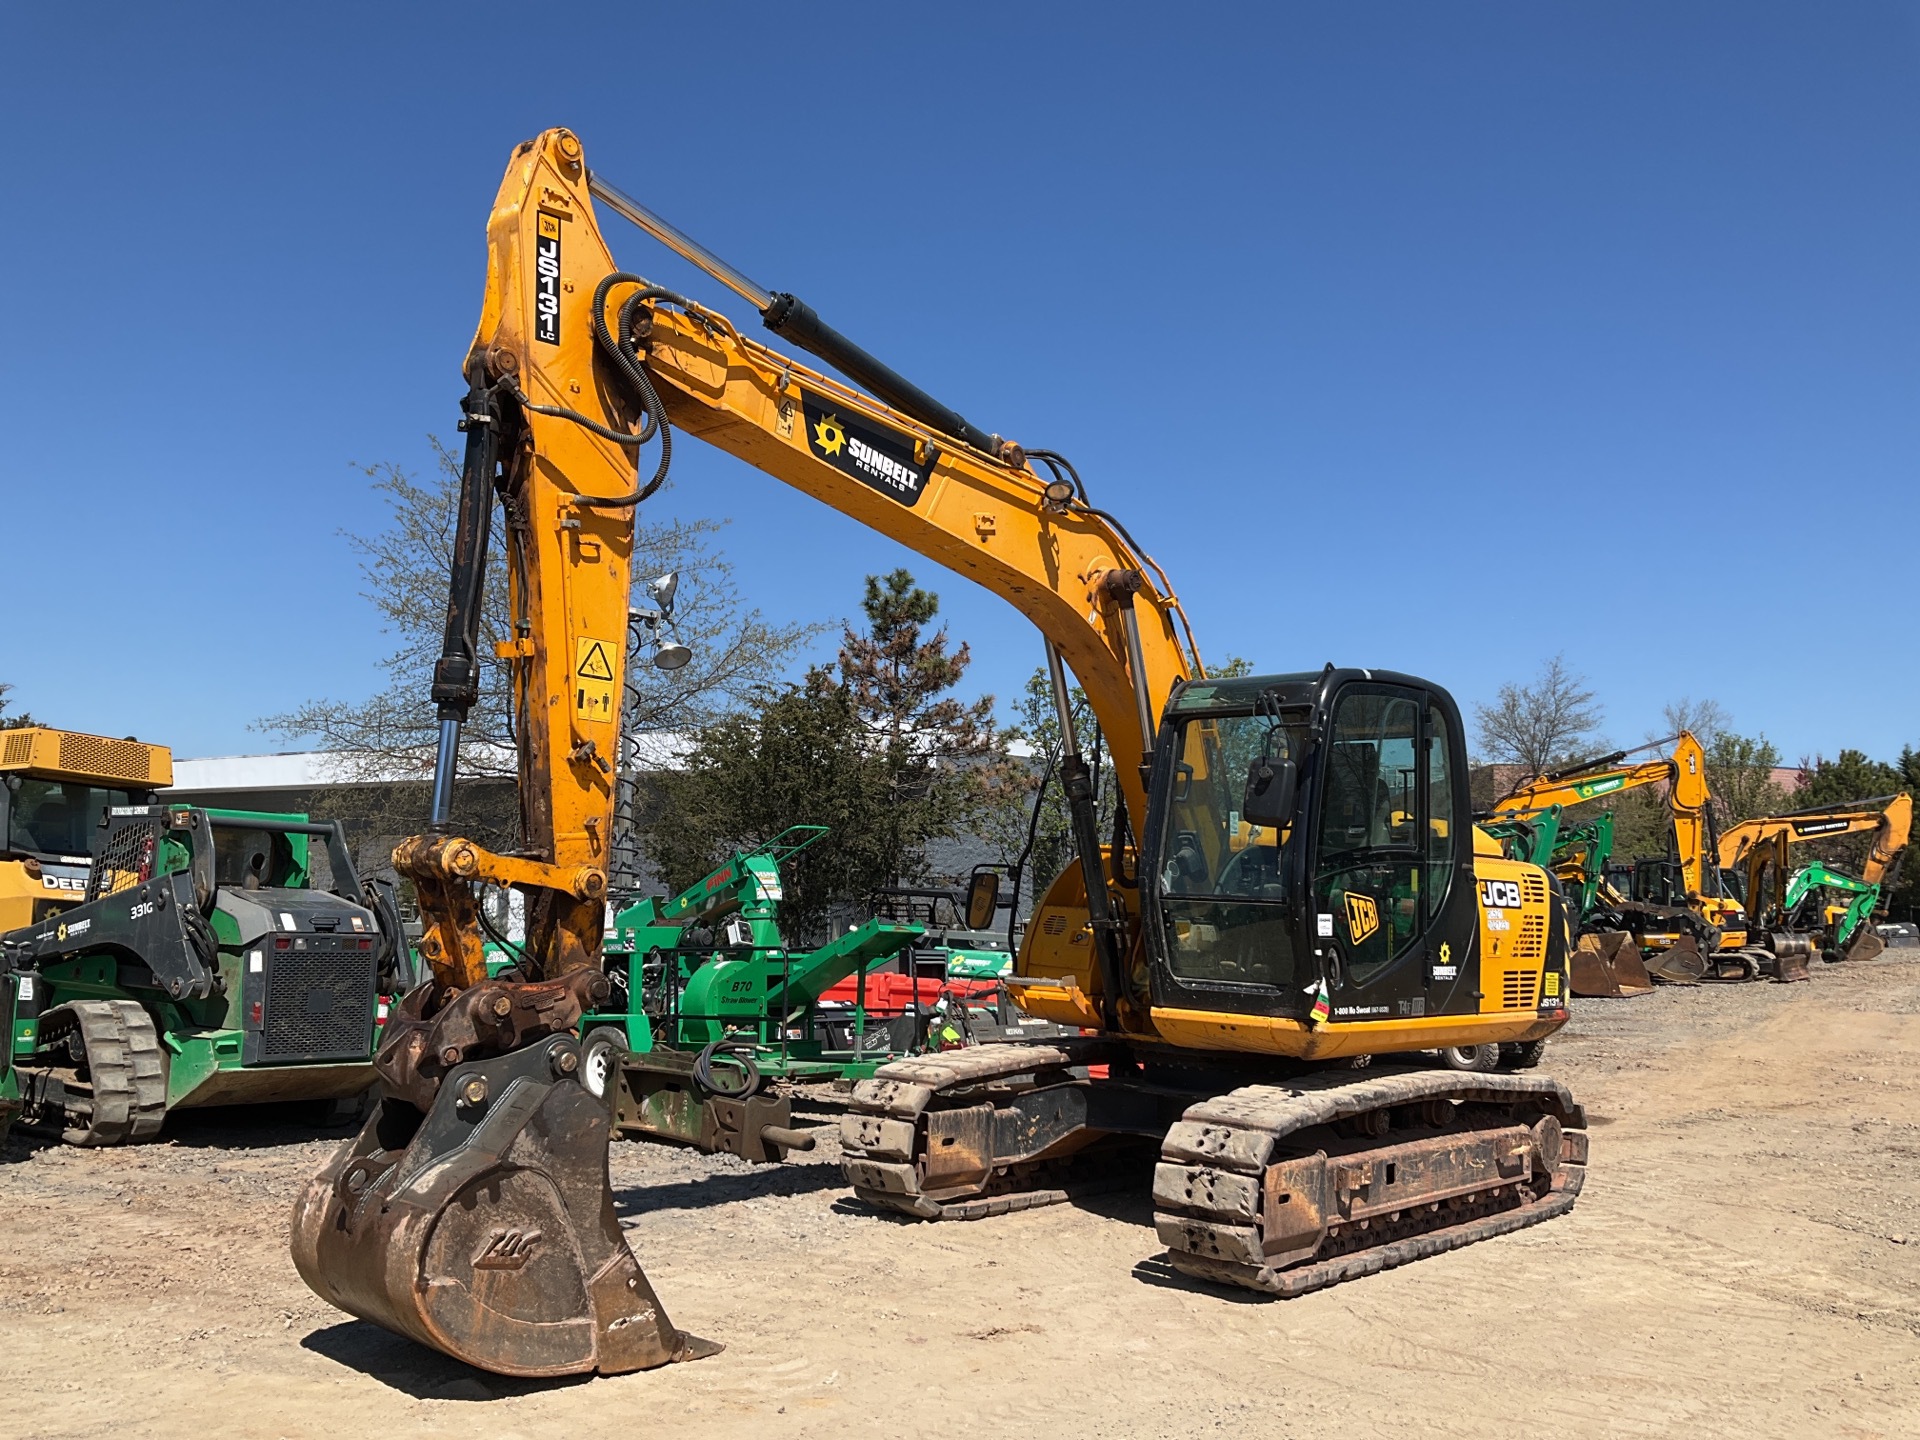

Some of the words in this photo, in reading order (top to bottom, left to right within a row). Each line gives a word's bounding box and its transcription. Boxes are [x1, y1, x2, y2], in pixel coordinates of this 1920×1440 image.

[537, 241, 559, 332] JS131
[540, 330, 555, 341] LC
[847, 436, 918, 490] SUNBELT
[855, 459, 905, 492] RENTALS
[705, 867, 732, 892] FINN
[1482, 881, 1521, 908] JCB
[130, 902, 153, 920] 331G
[1350, 897, 1378, 939] JCB
[1432, 965, 1457, 976] SUNBELT
[731, 981, 753, 992] B70
[720, 996, 738, 1004] Straw
[1540, 997, 1560, 1007] JS131
[1334, 1007, 1349, 1016] 1-800
[1355, 1005, 1371, 1015] Sweat
